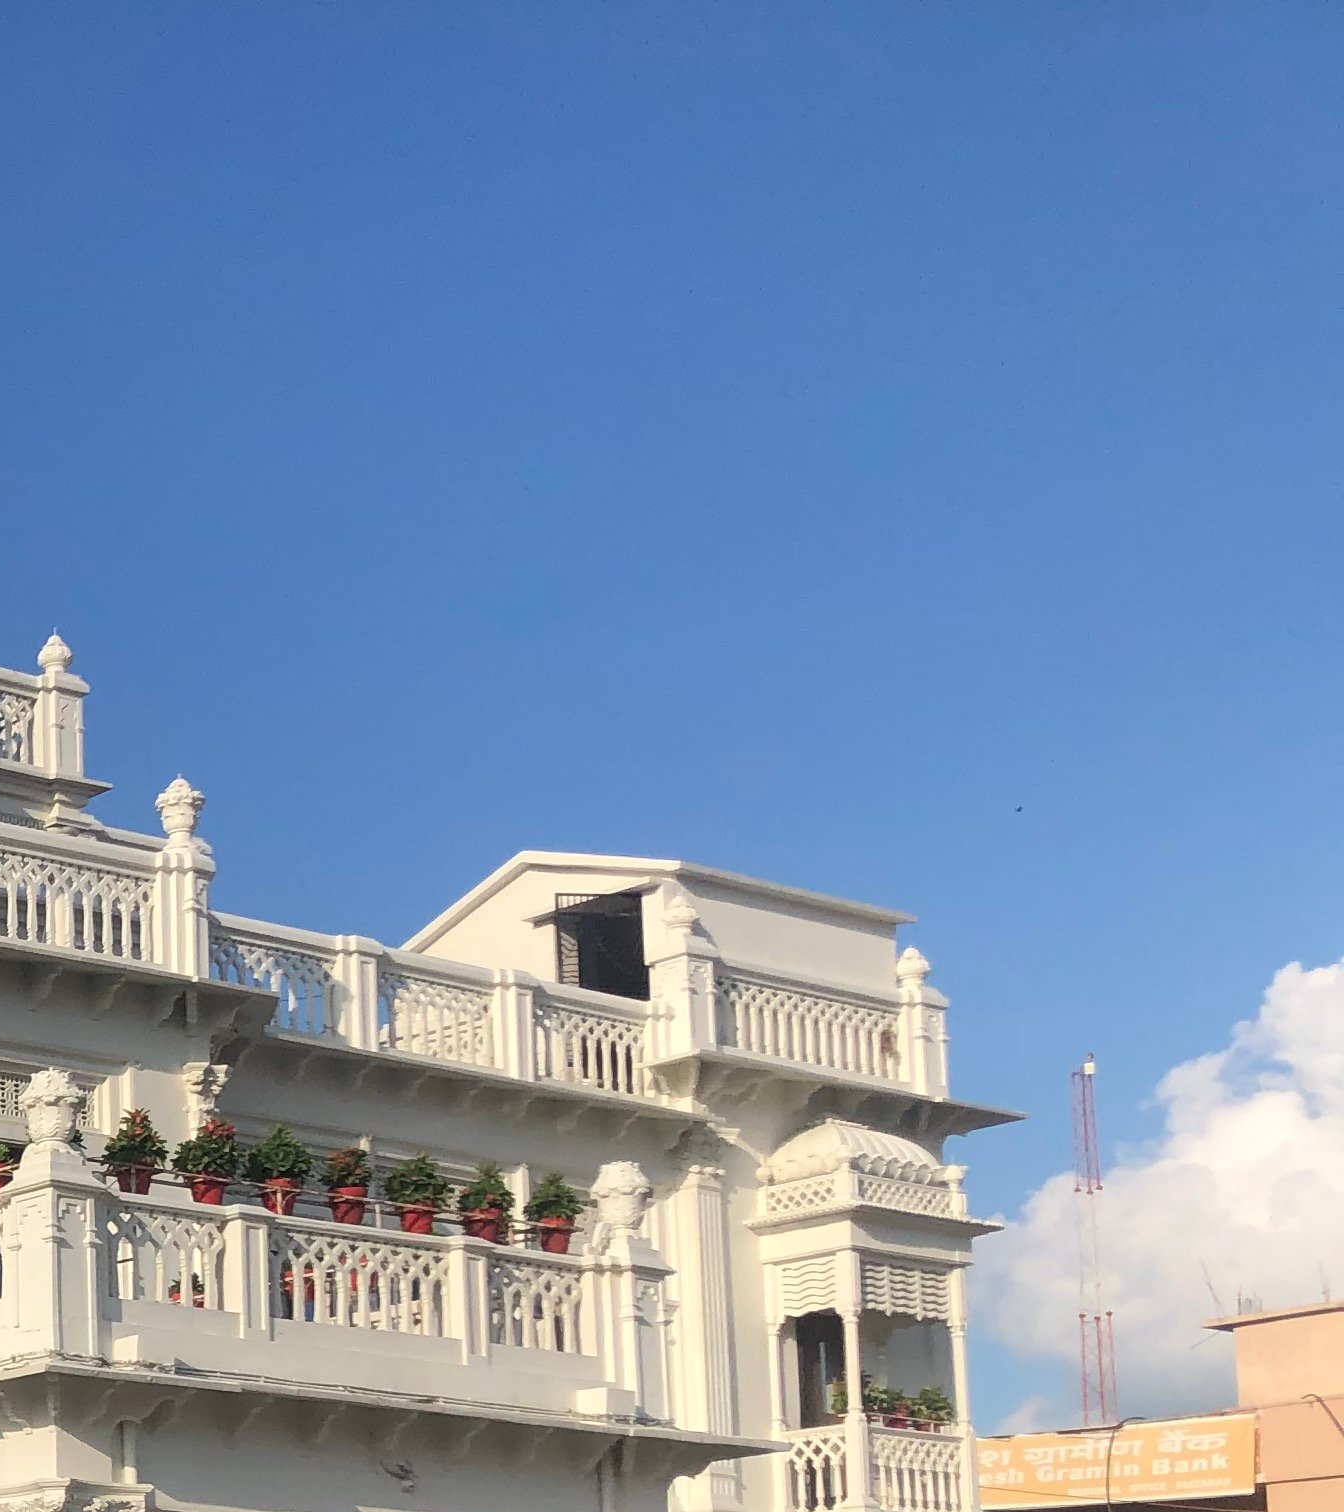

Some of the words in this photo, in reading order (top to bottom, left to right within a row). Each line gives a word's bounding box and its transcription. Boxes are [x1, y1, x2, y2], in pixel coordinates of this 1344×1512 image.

[978, 1467, 1025, 1486] esh
[1035, 1460, 1140, 1482] Gramin
[1152, 1453, 1229, 1476] Bank
